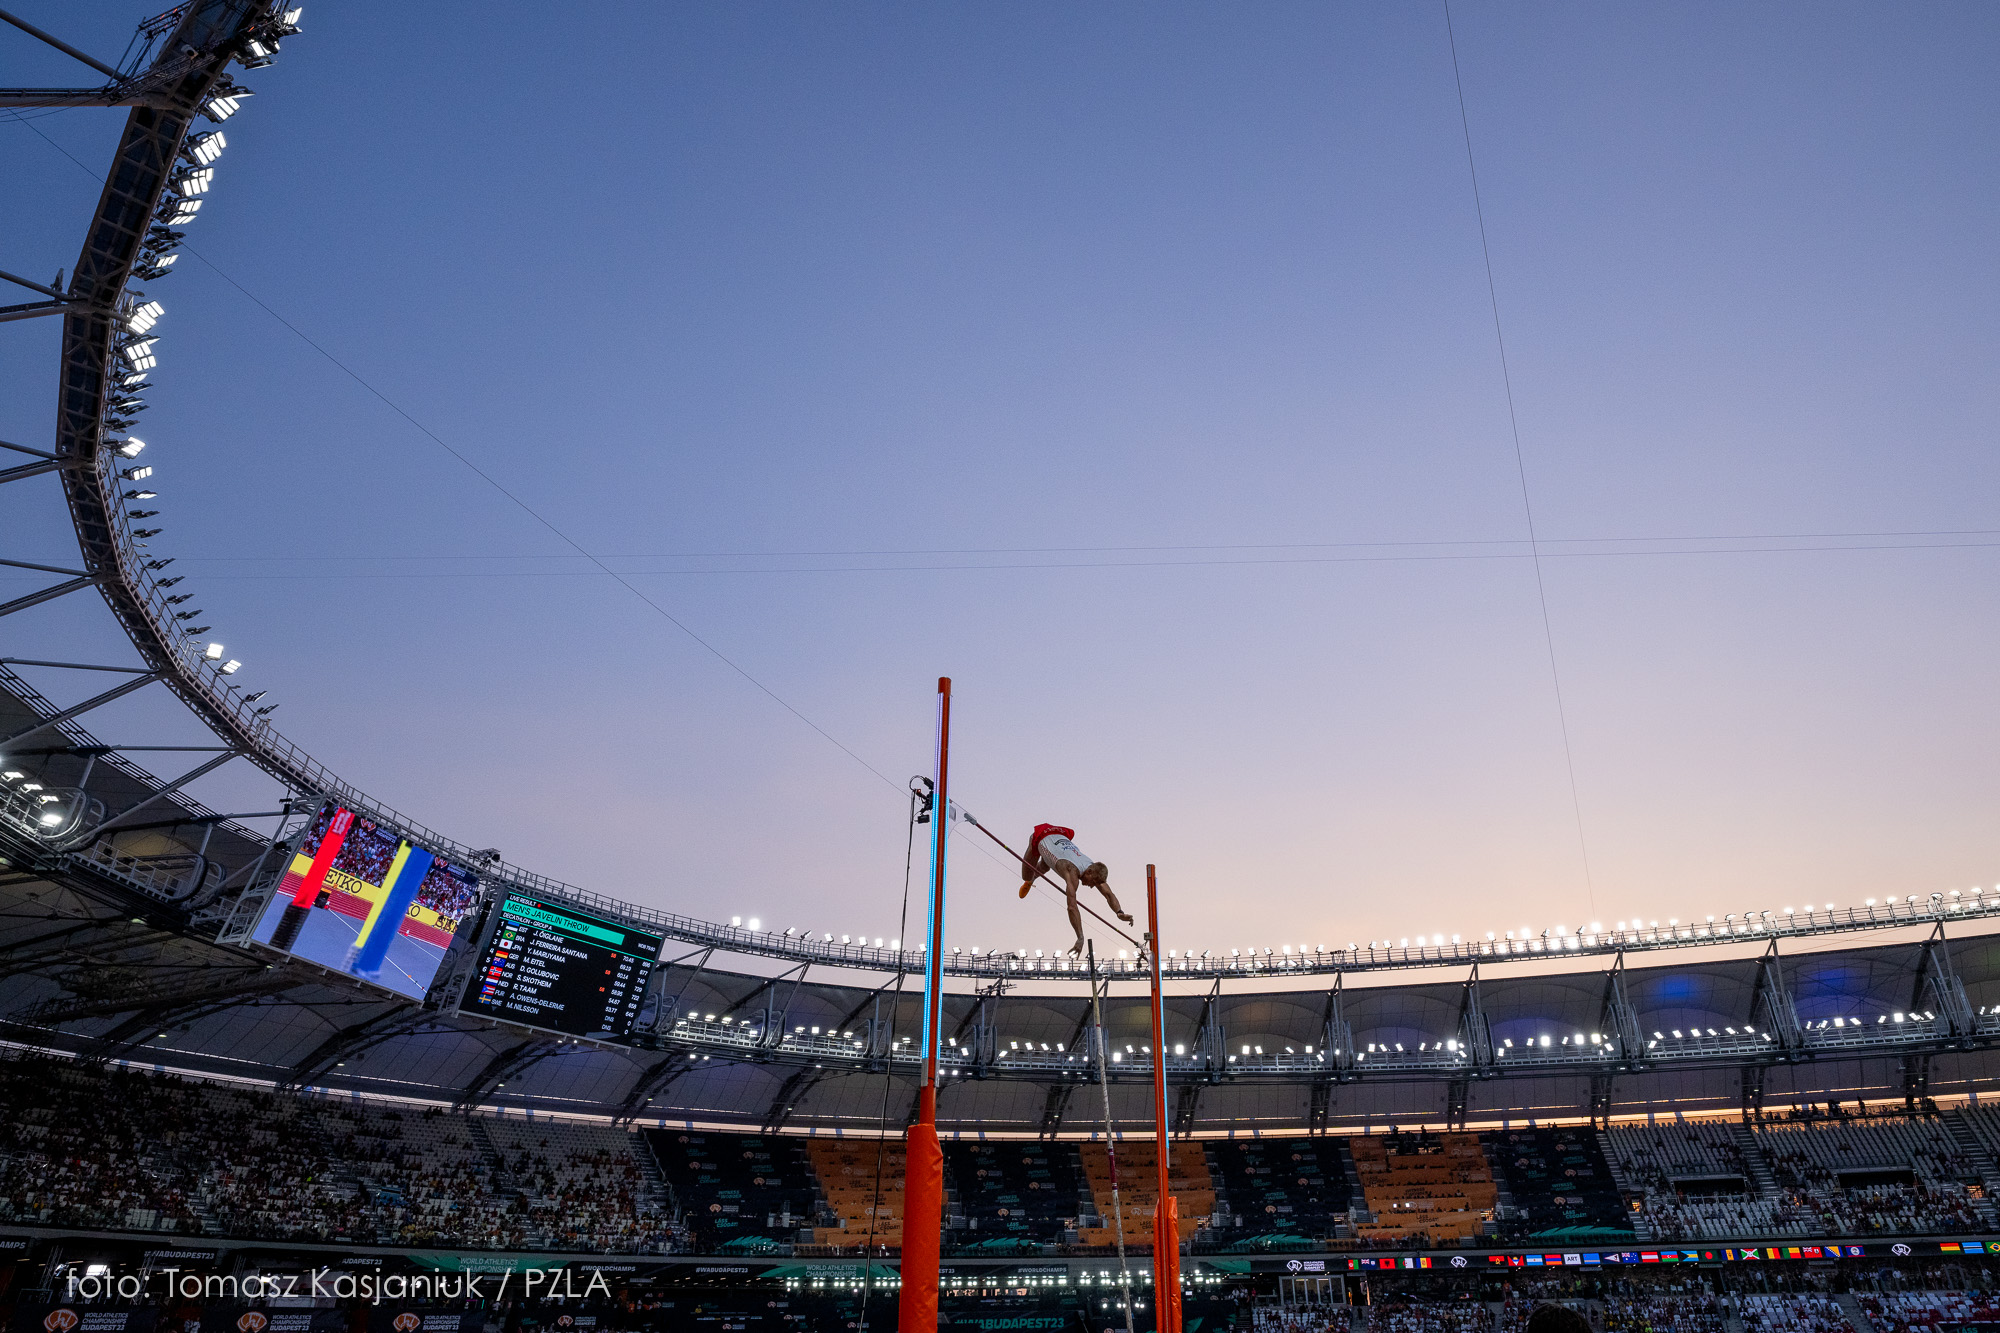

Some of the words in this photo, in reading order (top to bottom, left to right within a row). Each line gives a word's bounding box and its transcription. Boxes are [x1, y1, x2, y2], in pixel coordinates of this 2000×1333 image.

[326, 870, 362, 894] EIKO
[518, 897, 537, 906] RESULT
[503, 912, 530, 924] DECATHLON
[507, 902, 530, 915] MEN'S
[532, 909, 563, 924] JAVELIN
[564, 918, 590, 932] THROW
[533, 949, 566, 963] MARUYAMA
[536, 941, 561, 953] FERREIRA
[562, 948, 588, 959] SANTANA
[531, 959, 545, 967] EITEL
[526, 967, 560, 980] GOLUBOVIC
[523, 976, 552, 988] SKOTHEIM
[520, 985, 537, 994] TAAM
[516, 994, 564, 1010] OWENS-DELERME
[514, 1003, 539, 1014] NILSSON
[485, 1258, 518, 1266] ATHLETICS
